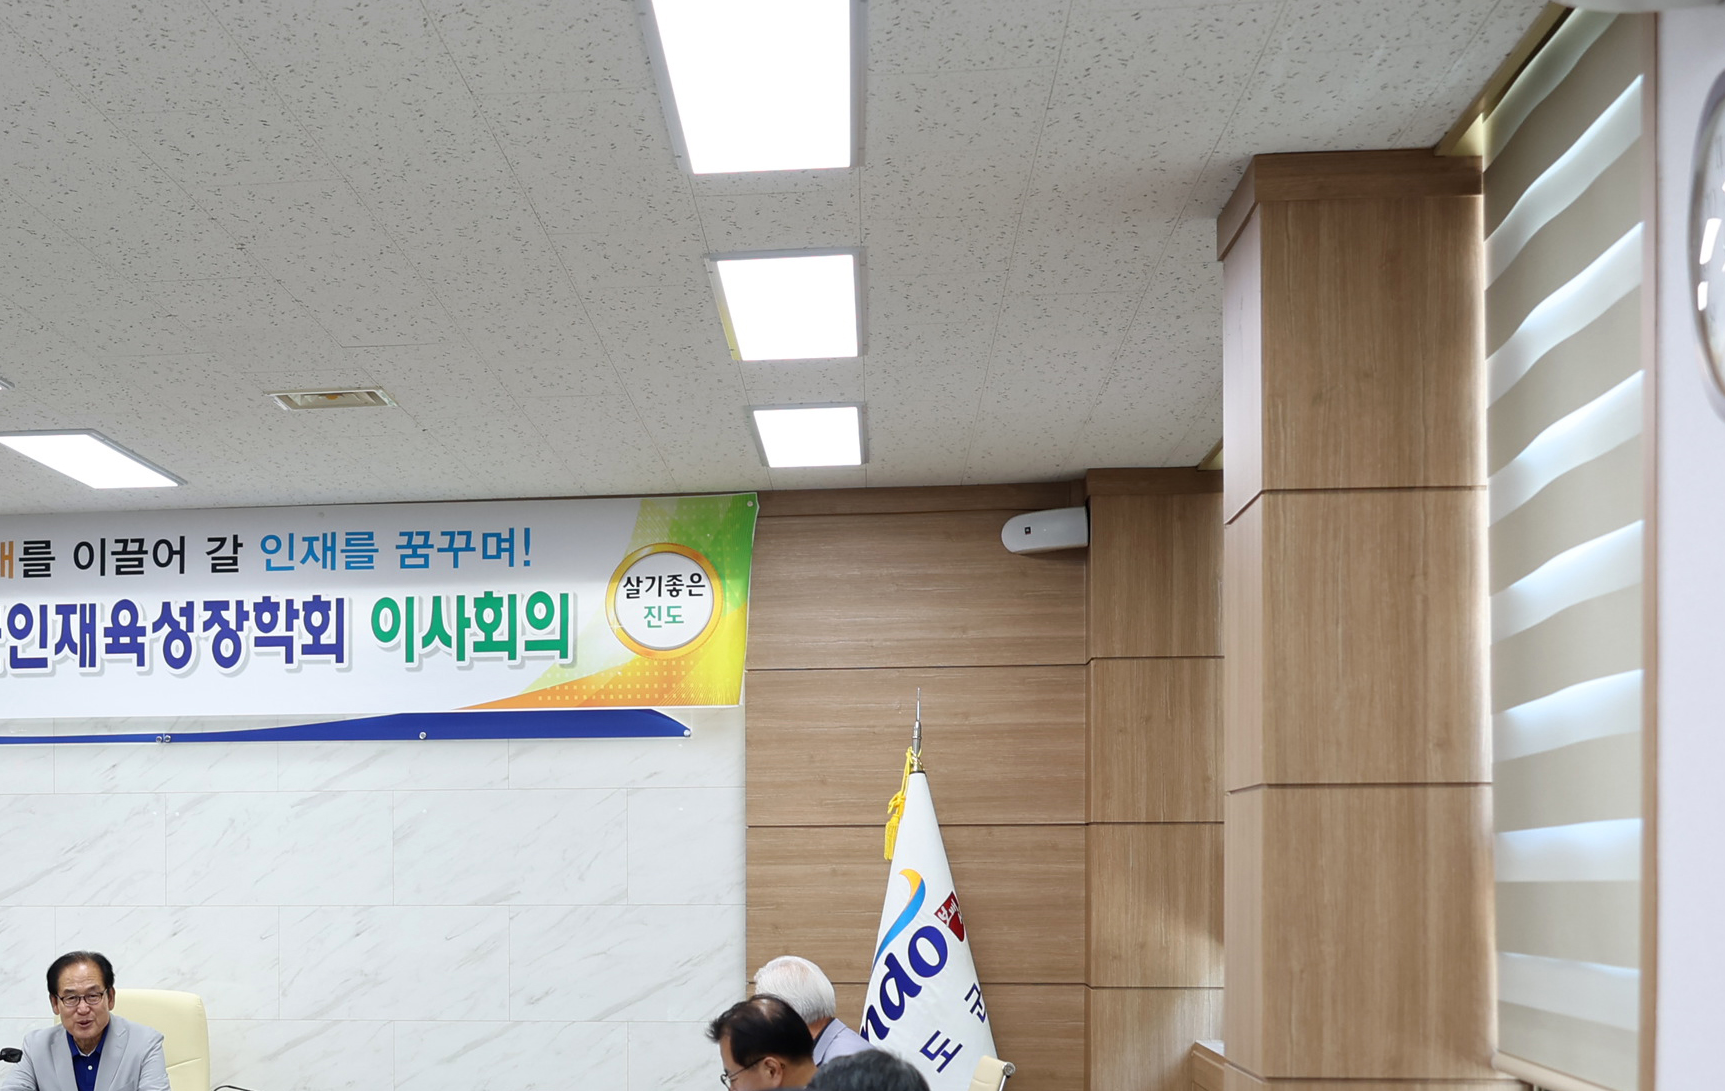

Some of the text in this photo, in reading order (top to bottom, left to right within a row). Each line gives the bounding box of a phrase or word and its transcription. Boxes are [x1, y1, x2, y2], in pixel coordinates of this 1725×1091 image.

[73, 535, 186, 577] 이끌어
[205, 533, 244, 574] 갈
[260, 529, 380, 573] 인재를
[395, 526, 532, 569] 꿈꾸며!
[622, 572, 706, 598] 살기좋은
[370, 589, 570, 665] 이사회의
[643, 604, 684, 628] 진도
